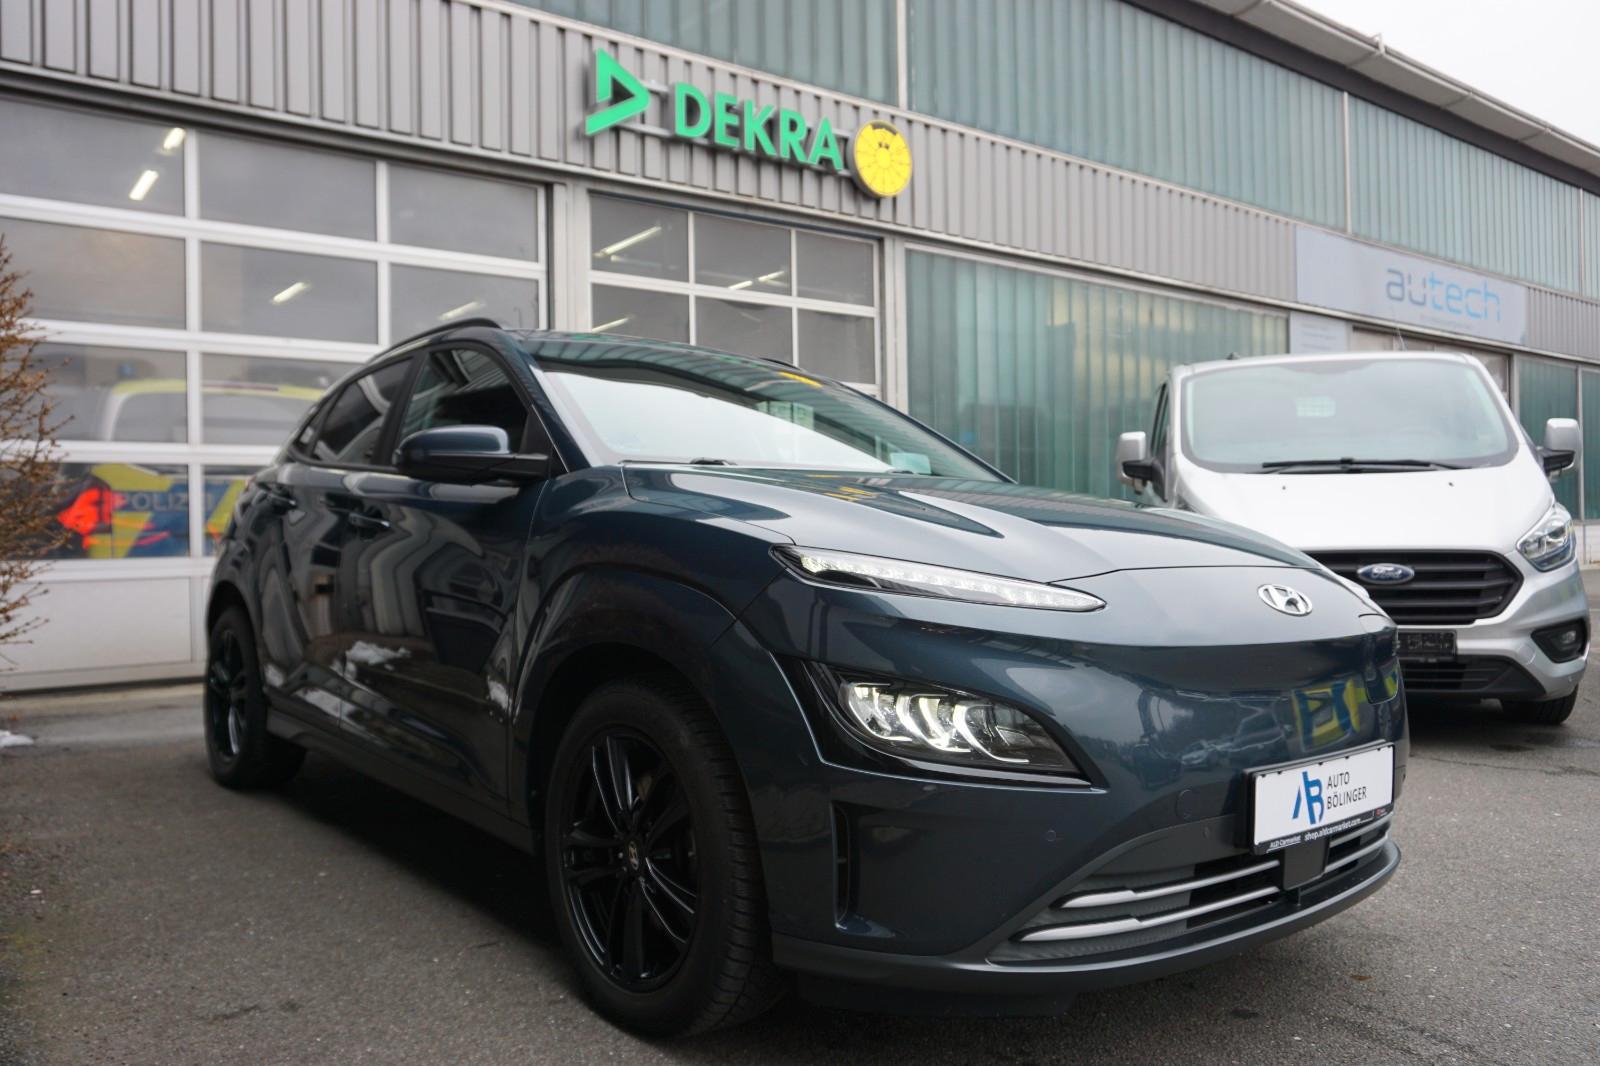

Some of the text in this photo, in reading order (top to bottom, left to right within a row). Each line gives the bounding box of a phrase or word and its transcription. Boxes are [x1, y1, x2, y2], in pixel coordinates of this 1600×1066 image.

[674, 82, 844, 171] DEKRA
[1385, 268, 1501, 322] autech
[1327, 771, 1350, 789] AUTO
[1327, 786, 1367, 810] BÖLINGER
